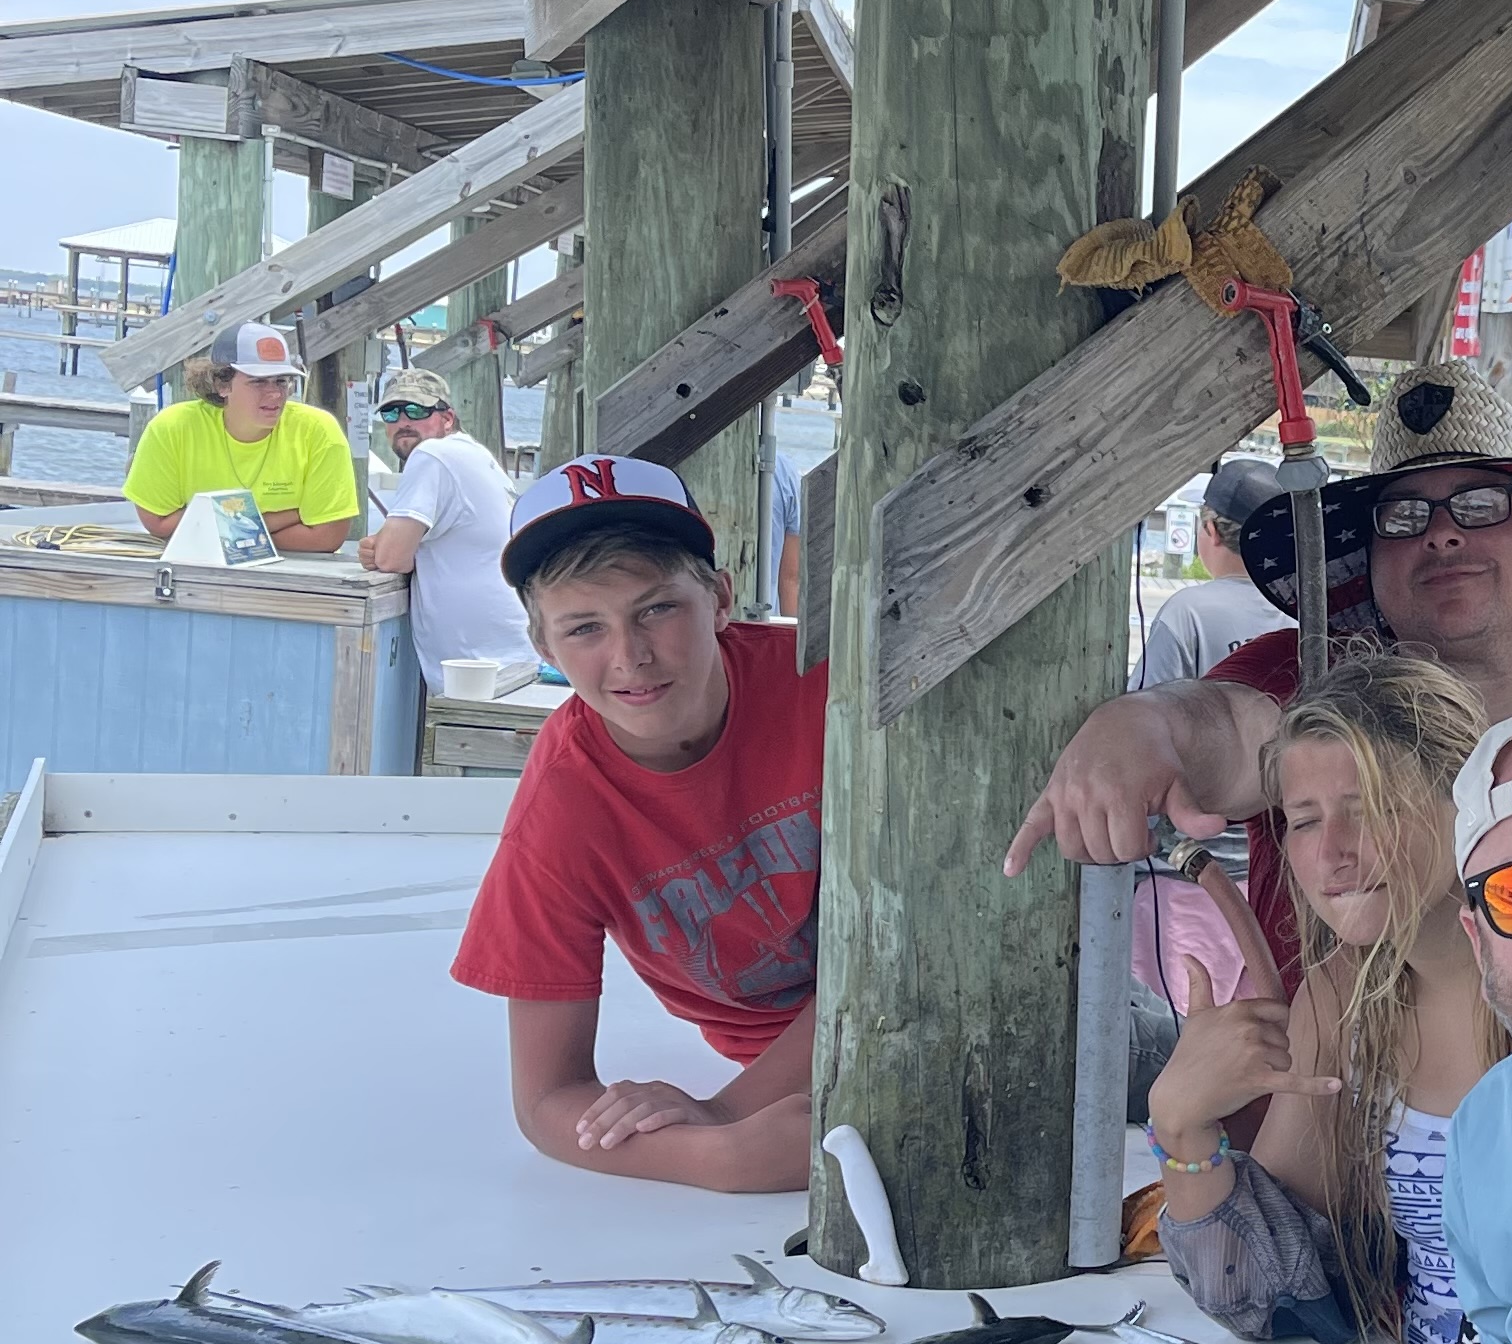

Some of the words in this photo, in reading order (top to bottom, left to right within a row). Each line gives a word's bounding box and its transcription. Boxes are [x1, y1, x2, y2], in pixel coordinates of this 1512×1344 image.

[560, 459, 617, 507] N
[739, 785, 821, 833] FOOTBAL
[631, 809, 821, 955] FALCON
